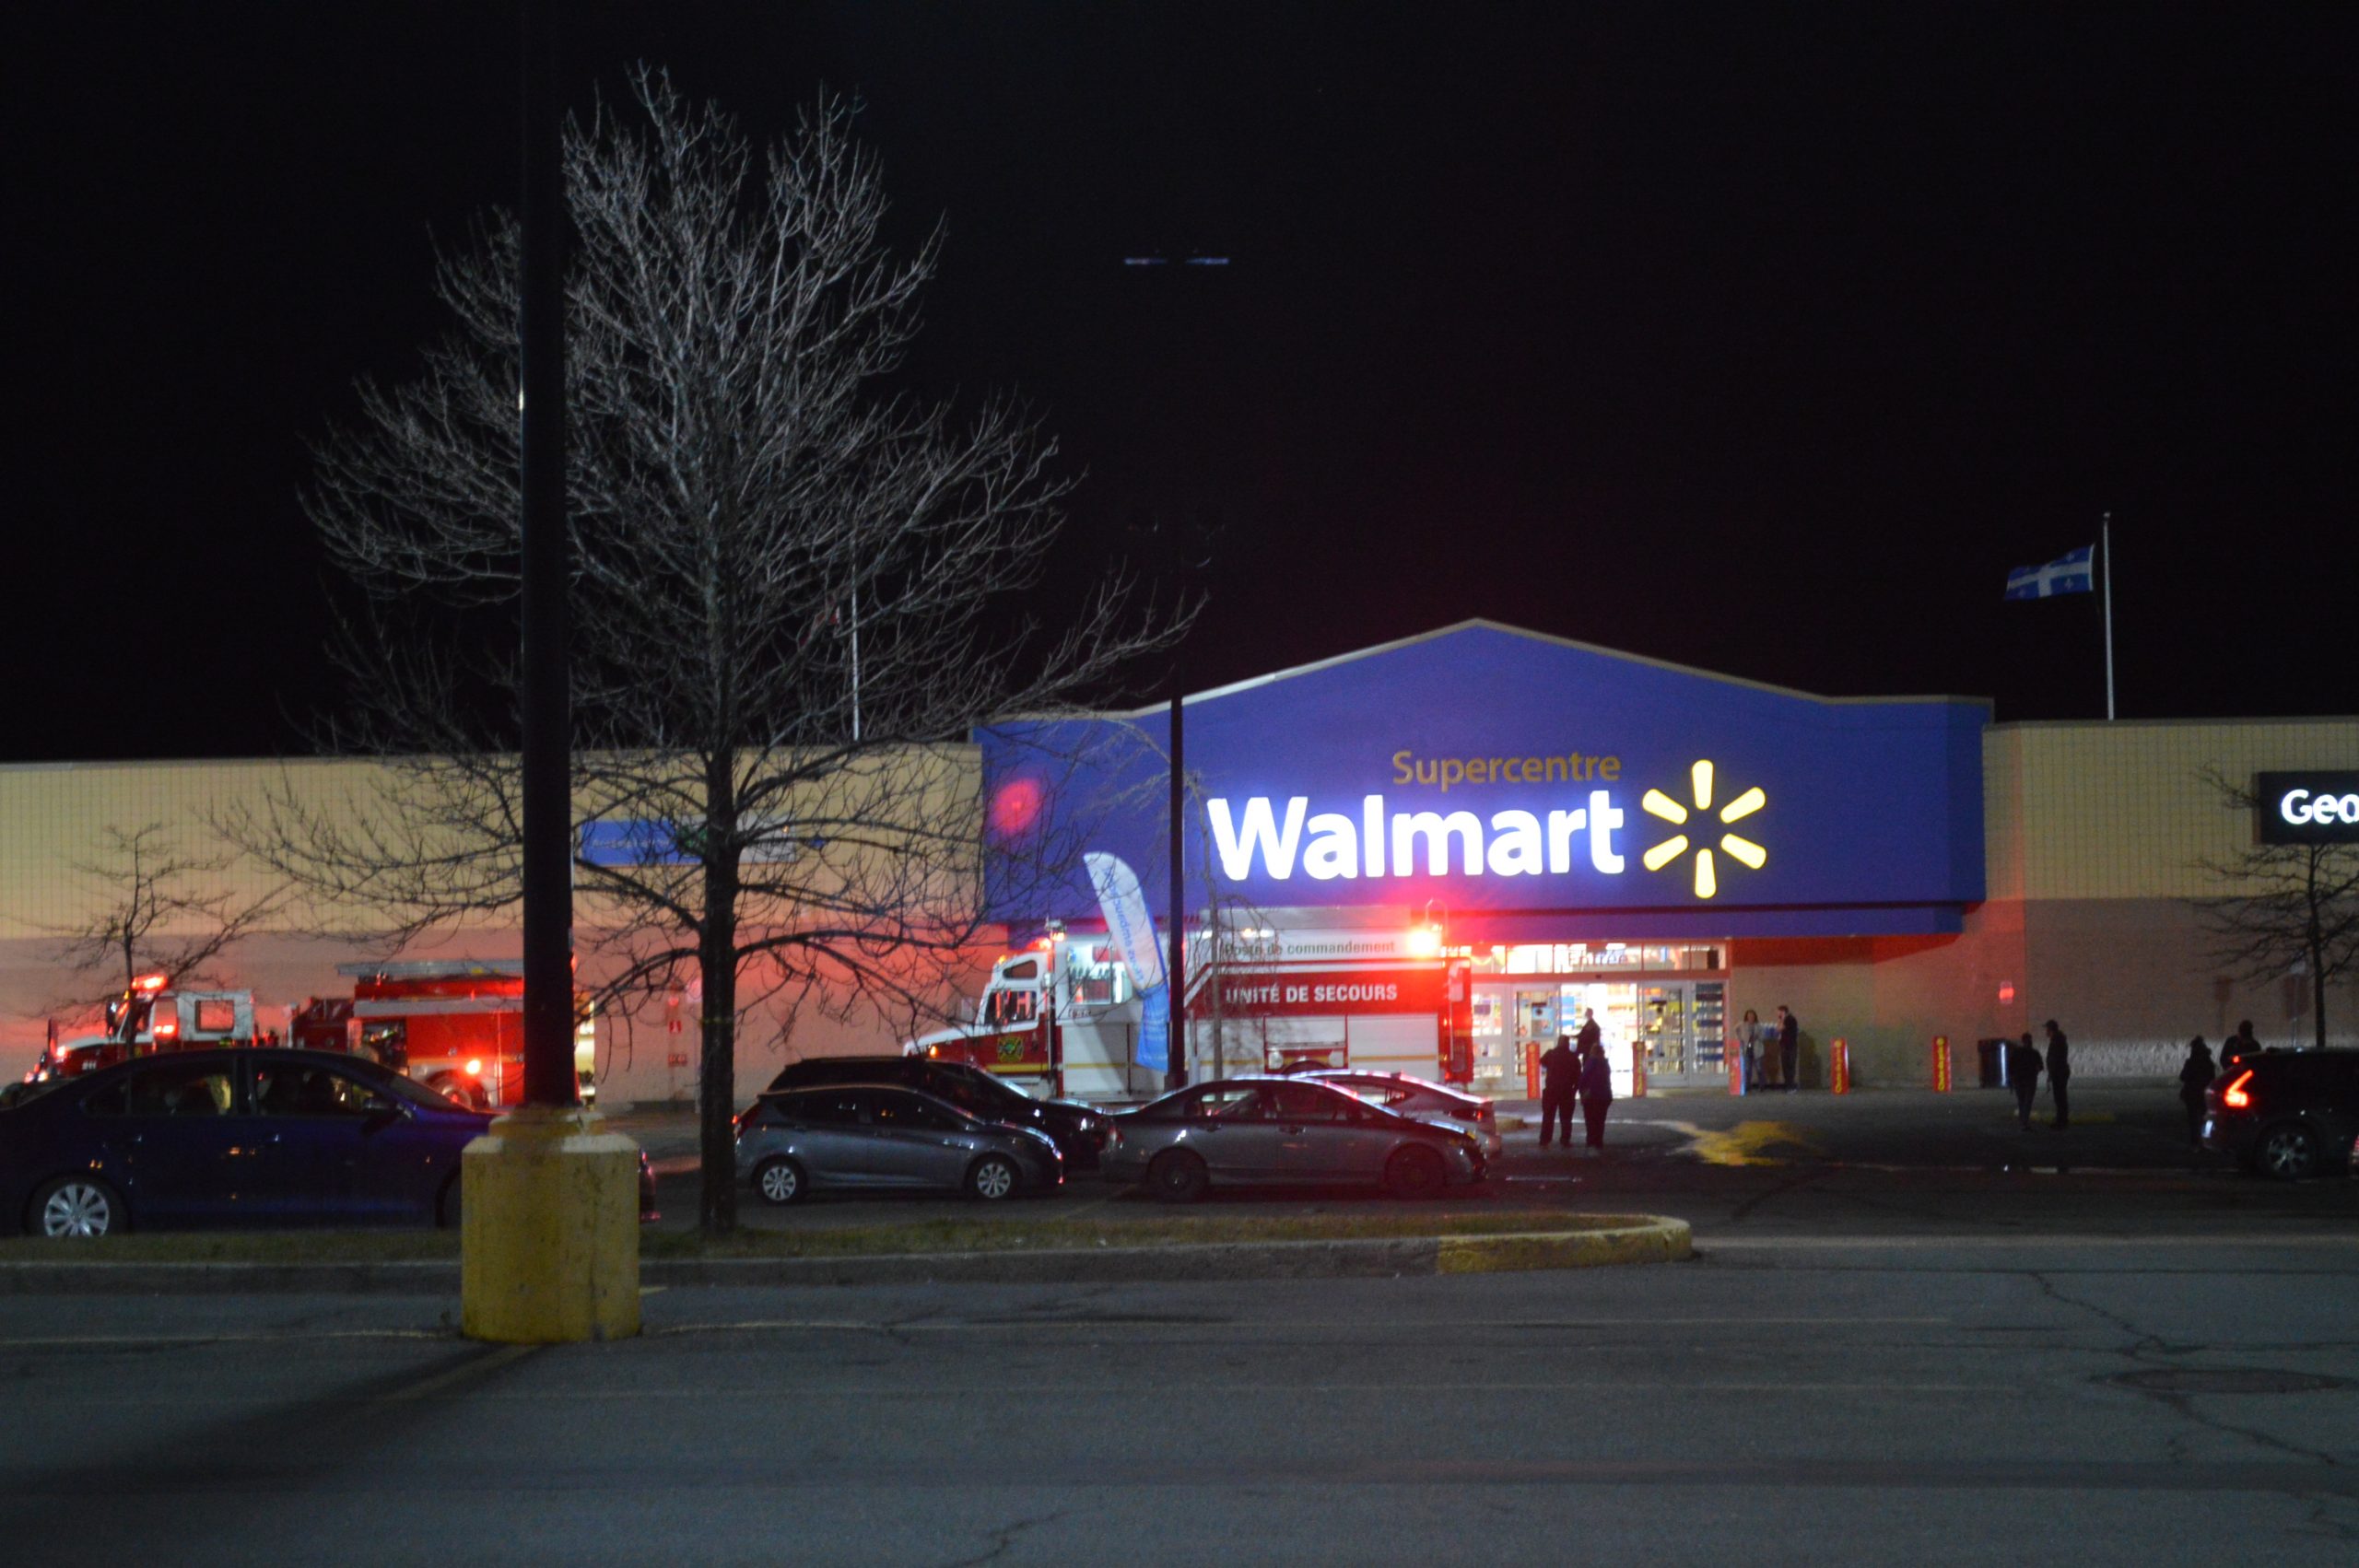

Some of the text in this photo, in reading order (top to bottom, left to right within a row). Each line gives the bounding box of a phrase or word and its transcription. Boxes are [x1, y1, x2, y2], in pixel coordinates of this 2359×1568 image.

[1392, 750, 1622, 792] Supercentre
[1207, 790, 1625, 881] Walmart
[1267, 942, 1283, 955] de
[1287, 941, 1396, 954] commandement
[1226, 983, 1398, 1004] UNITÉ DE SECOURS
